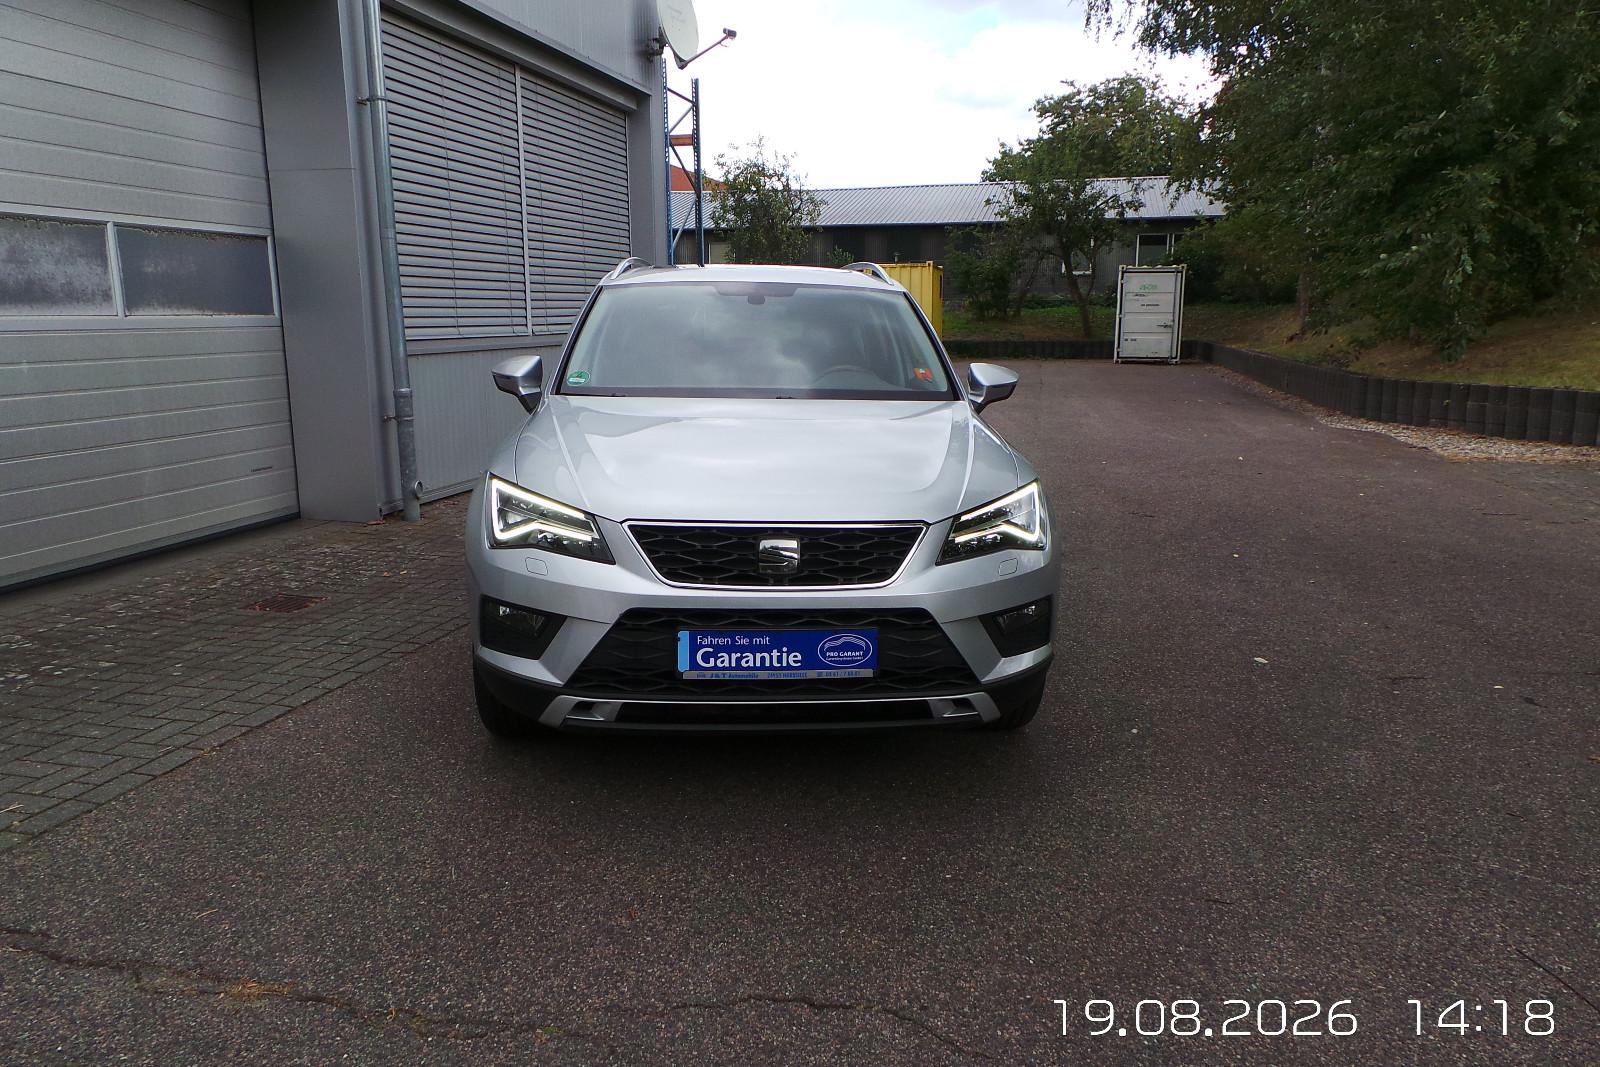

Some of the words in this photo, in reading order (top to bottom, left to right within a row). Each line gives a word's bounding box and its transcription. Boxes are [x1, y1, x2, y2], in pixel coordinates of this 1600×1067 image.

[697, 635, 731, 645] Fahren
[735, 635, 750, 645] Sie
[753, 635, 770, 645] mit
[696, 646, 802, 668] Garantie
